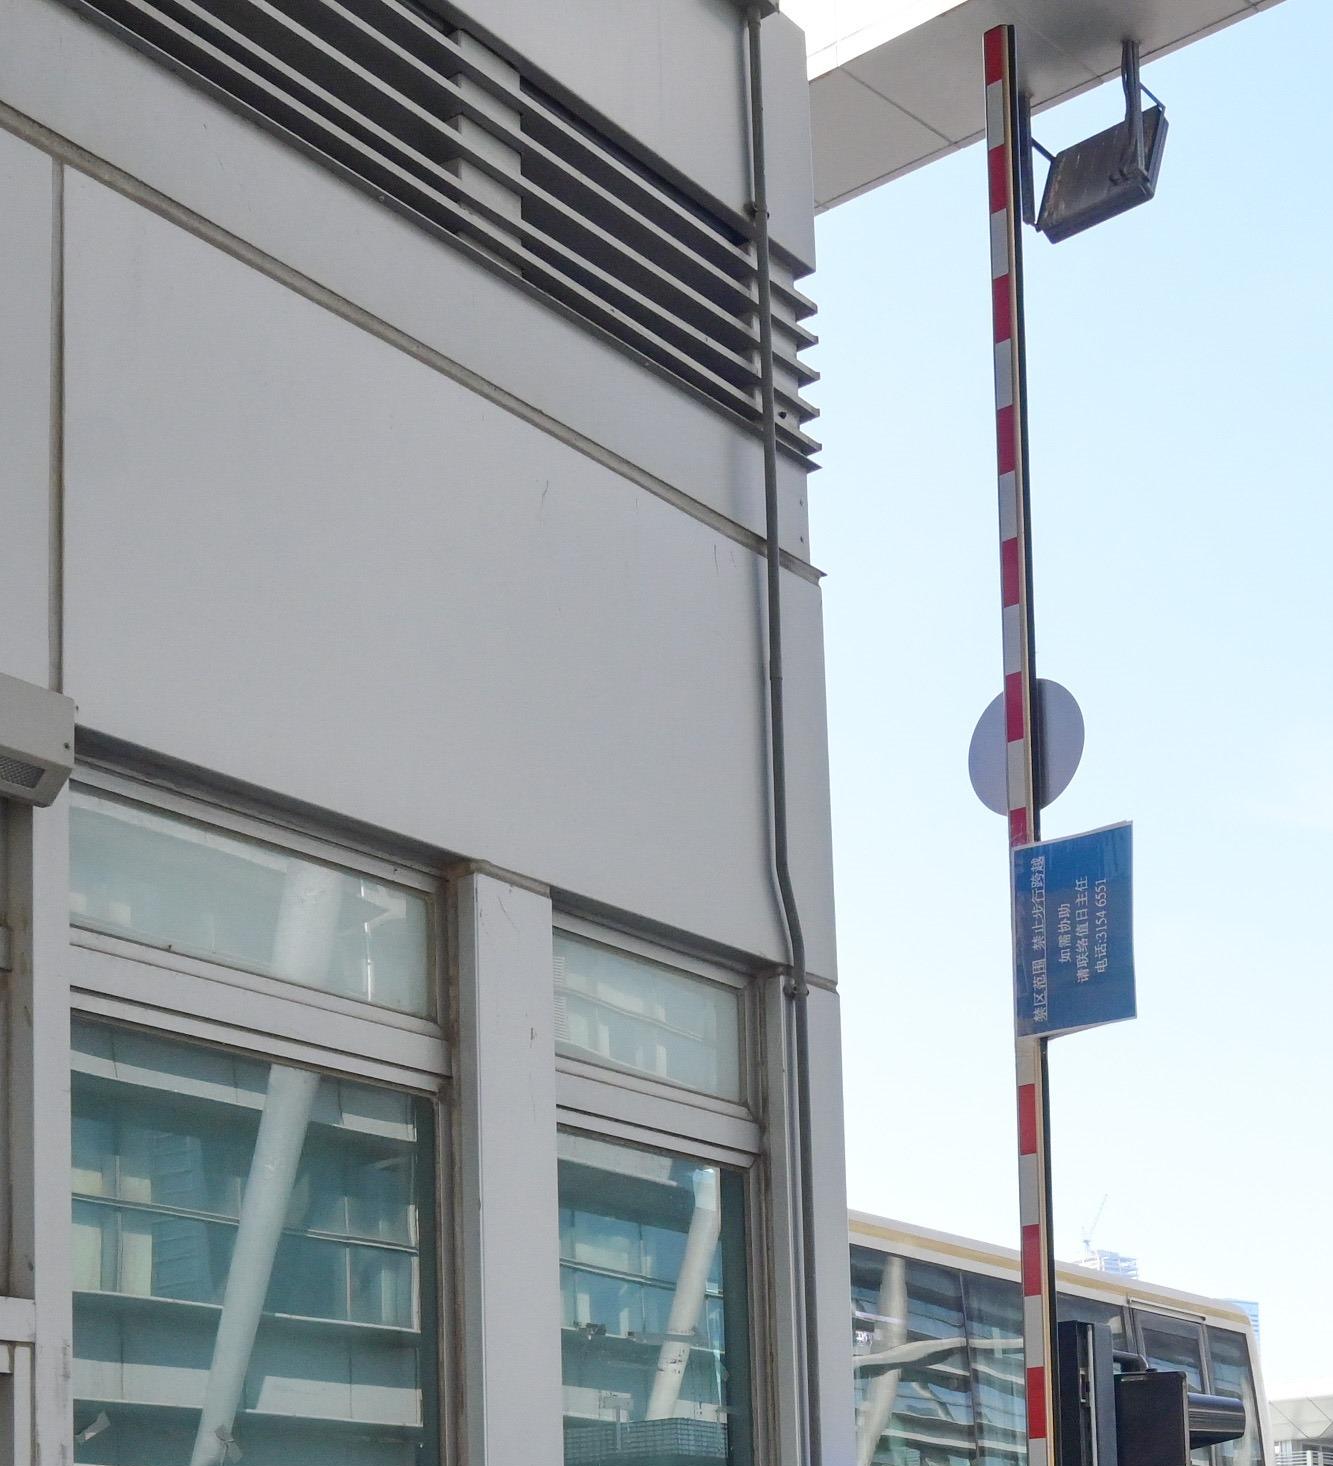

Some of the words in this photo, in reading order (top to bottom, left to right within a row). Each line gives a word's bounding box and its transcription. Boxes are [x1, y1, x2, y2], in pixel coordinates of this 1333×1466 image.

[1095, 879, 1107, 907] 6551
[1058, 903, 1071, 963] 如需协助
[1075, 875, 1089, 983] 请联络值日主任
[1031, 958, 1047, 1022] 禁区范围
